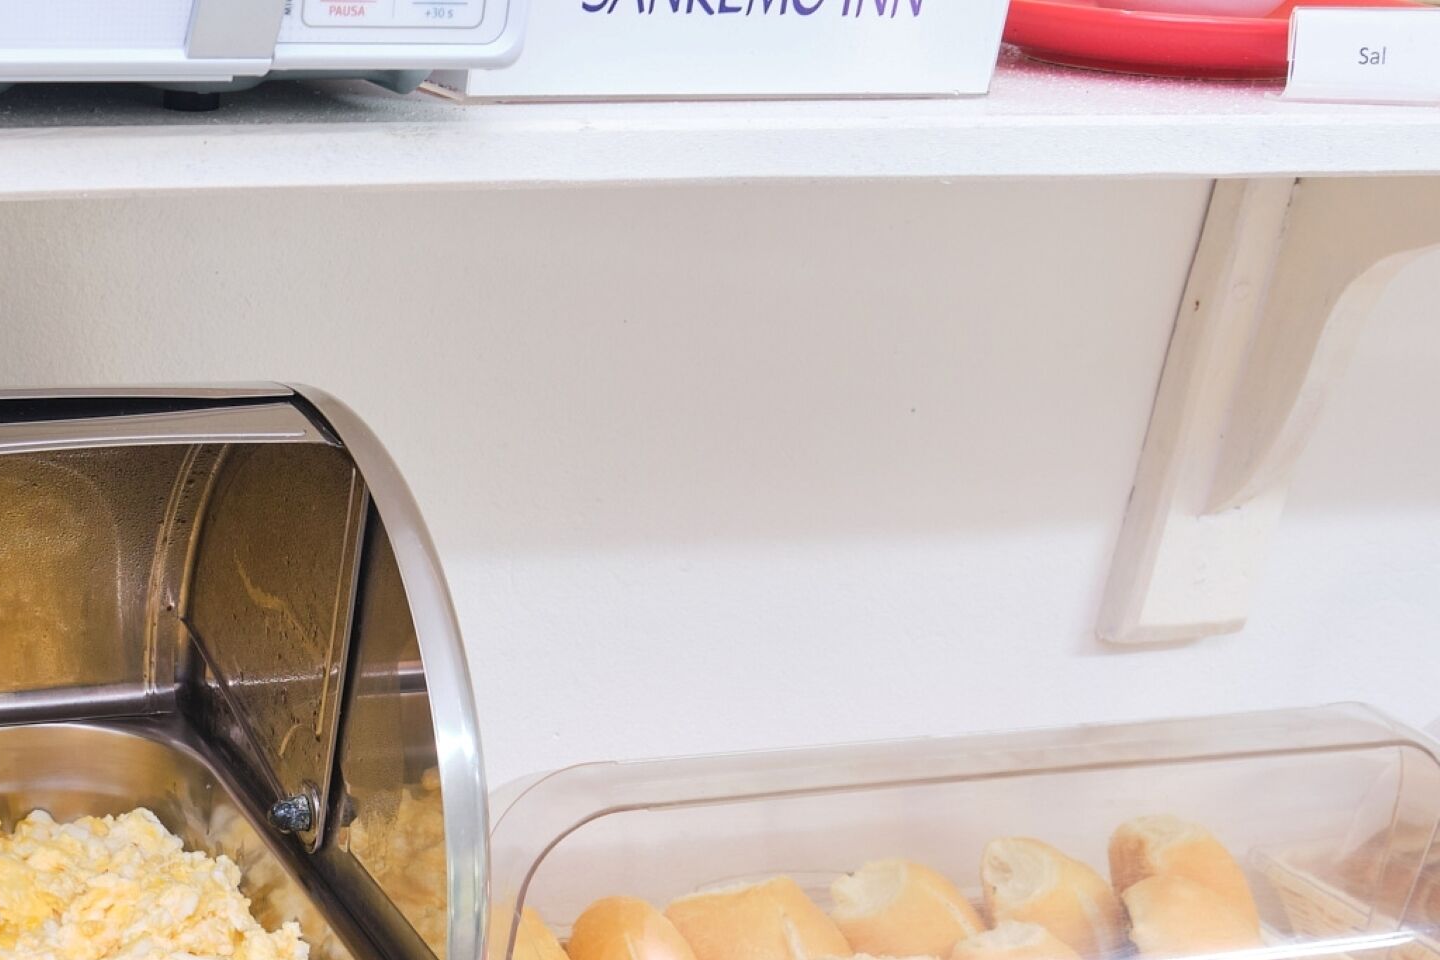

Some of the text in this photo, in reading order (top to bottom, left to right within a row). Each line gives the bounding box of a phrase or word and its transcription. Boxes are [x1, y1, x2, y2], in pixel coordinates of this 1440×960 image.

[328, 5, 365, 17] PAUSA
[425, 7, 445, 17] +30
[1358, 46, 1387, 65] Sal
